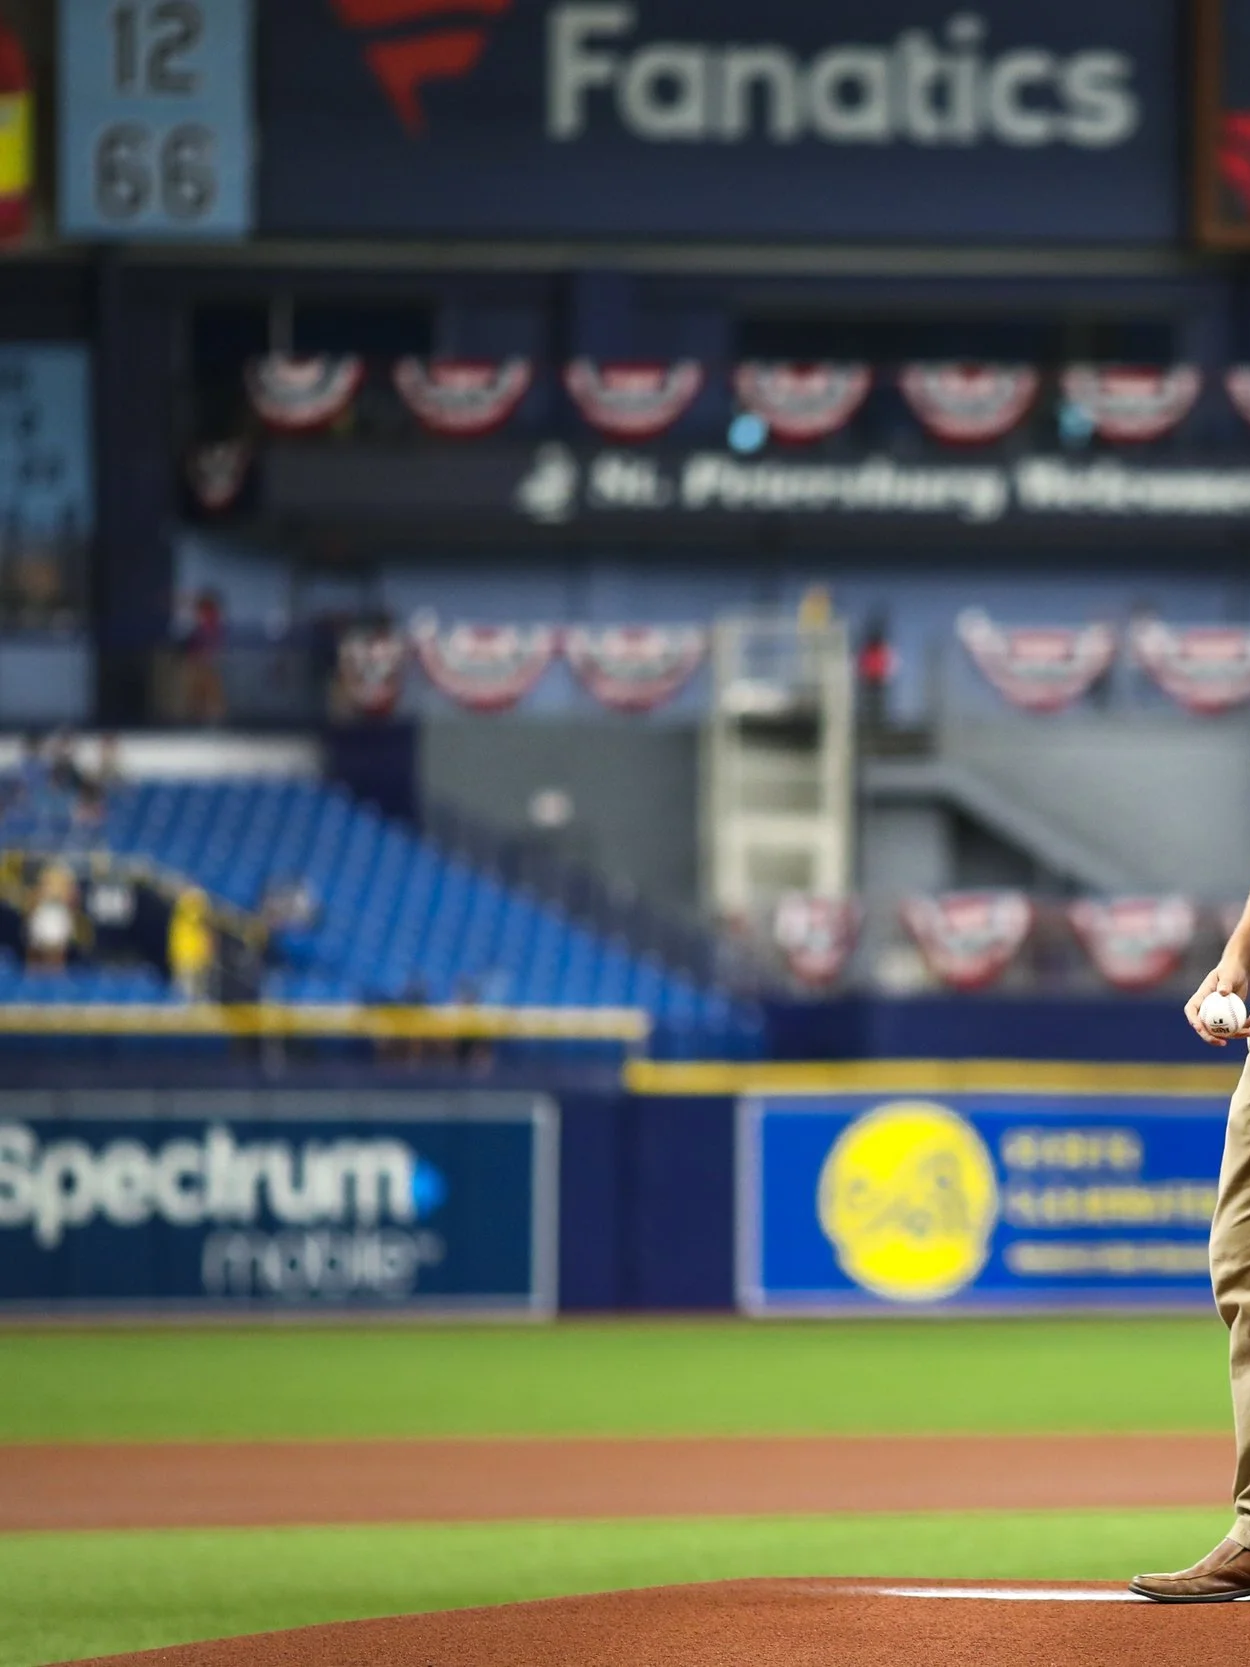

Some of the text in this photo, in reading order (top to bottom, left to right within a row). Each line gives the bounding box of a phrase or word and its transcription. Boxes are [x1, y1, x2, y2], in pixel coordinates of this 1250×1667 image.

[109, 0, 204, 97] 12
[544, 2, 1139, 148] Fanatics
[95, 121, 220, 224] 66
[0, 1121, 418, 1249] Spectrum
